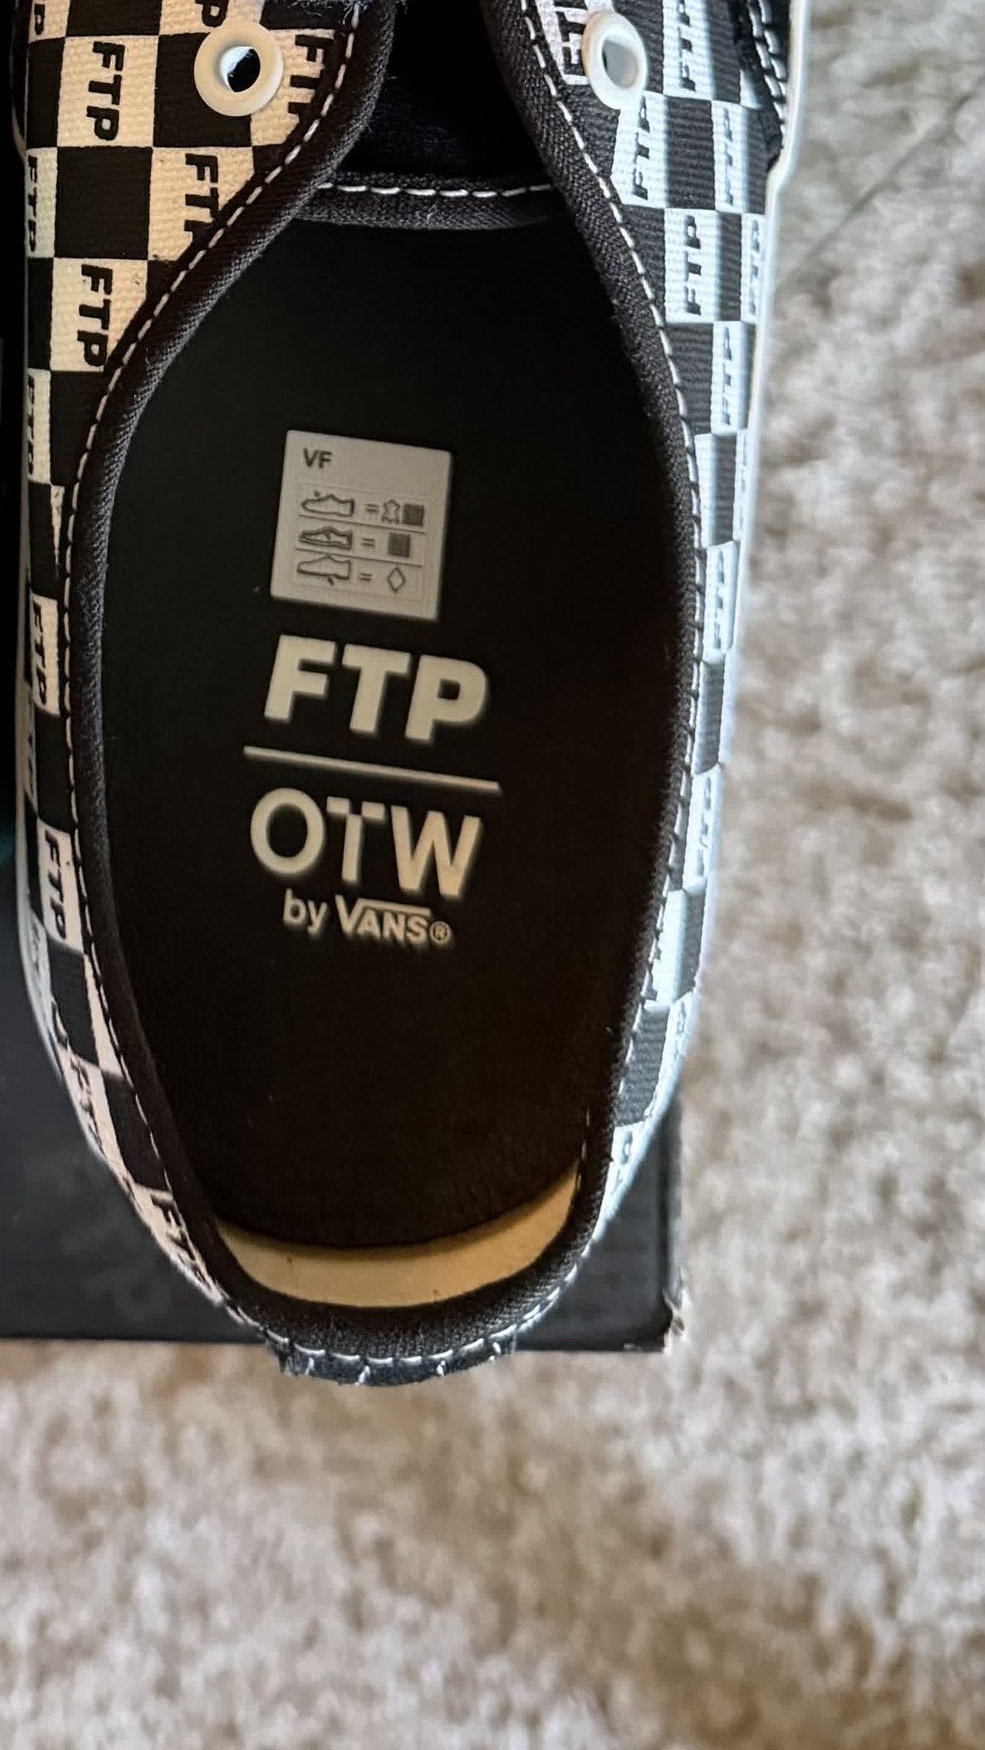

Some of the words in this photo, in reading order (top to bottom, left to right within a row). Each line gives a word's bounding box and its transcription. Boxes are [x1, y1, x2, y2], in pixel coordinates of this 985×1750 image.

[86, 41, 125, 140] FTP
[632, 96, 650, 200] FTP
[77, 263, 113, 367] FTP
[683, 215, 701, 316] FTP
[302, 448, 332, 468] VF
[264, 634, 489, 742] FTP
[44, 829, 66, 939] FTP
[250, 787, 482, 899] OTW
[283, 887, 328, 937] by
